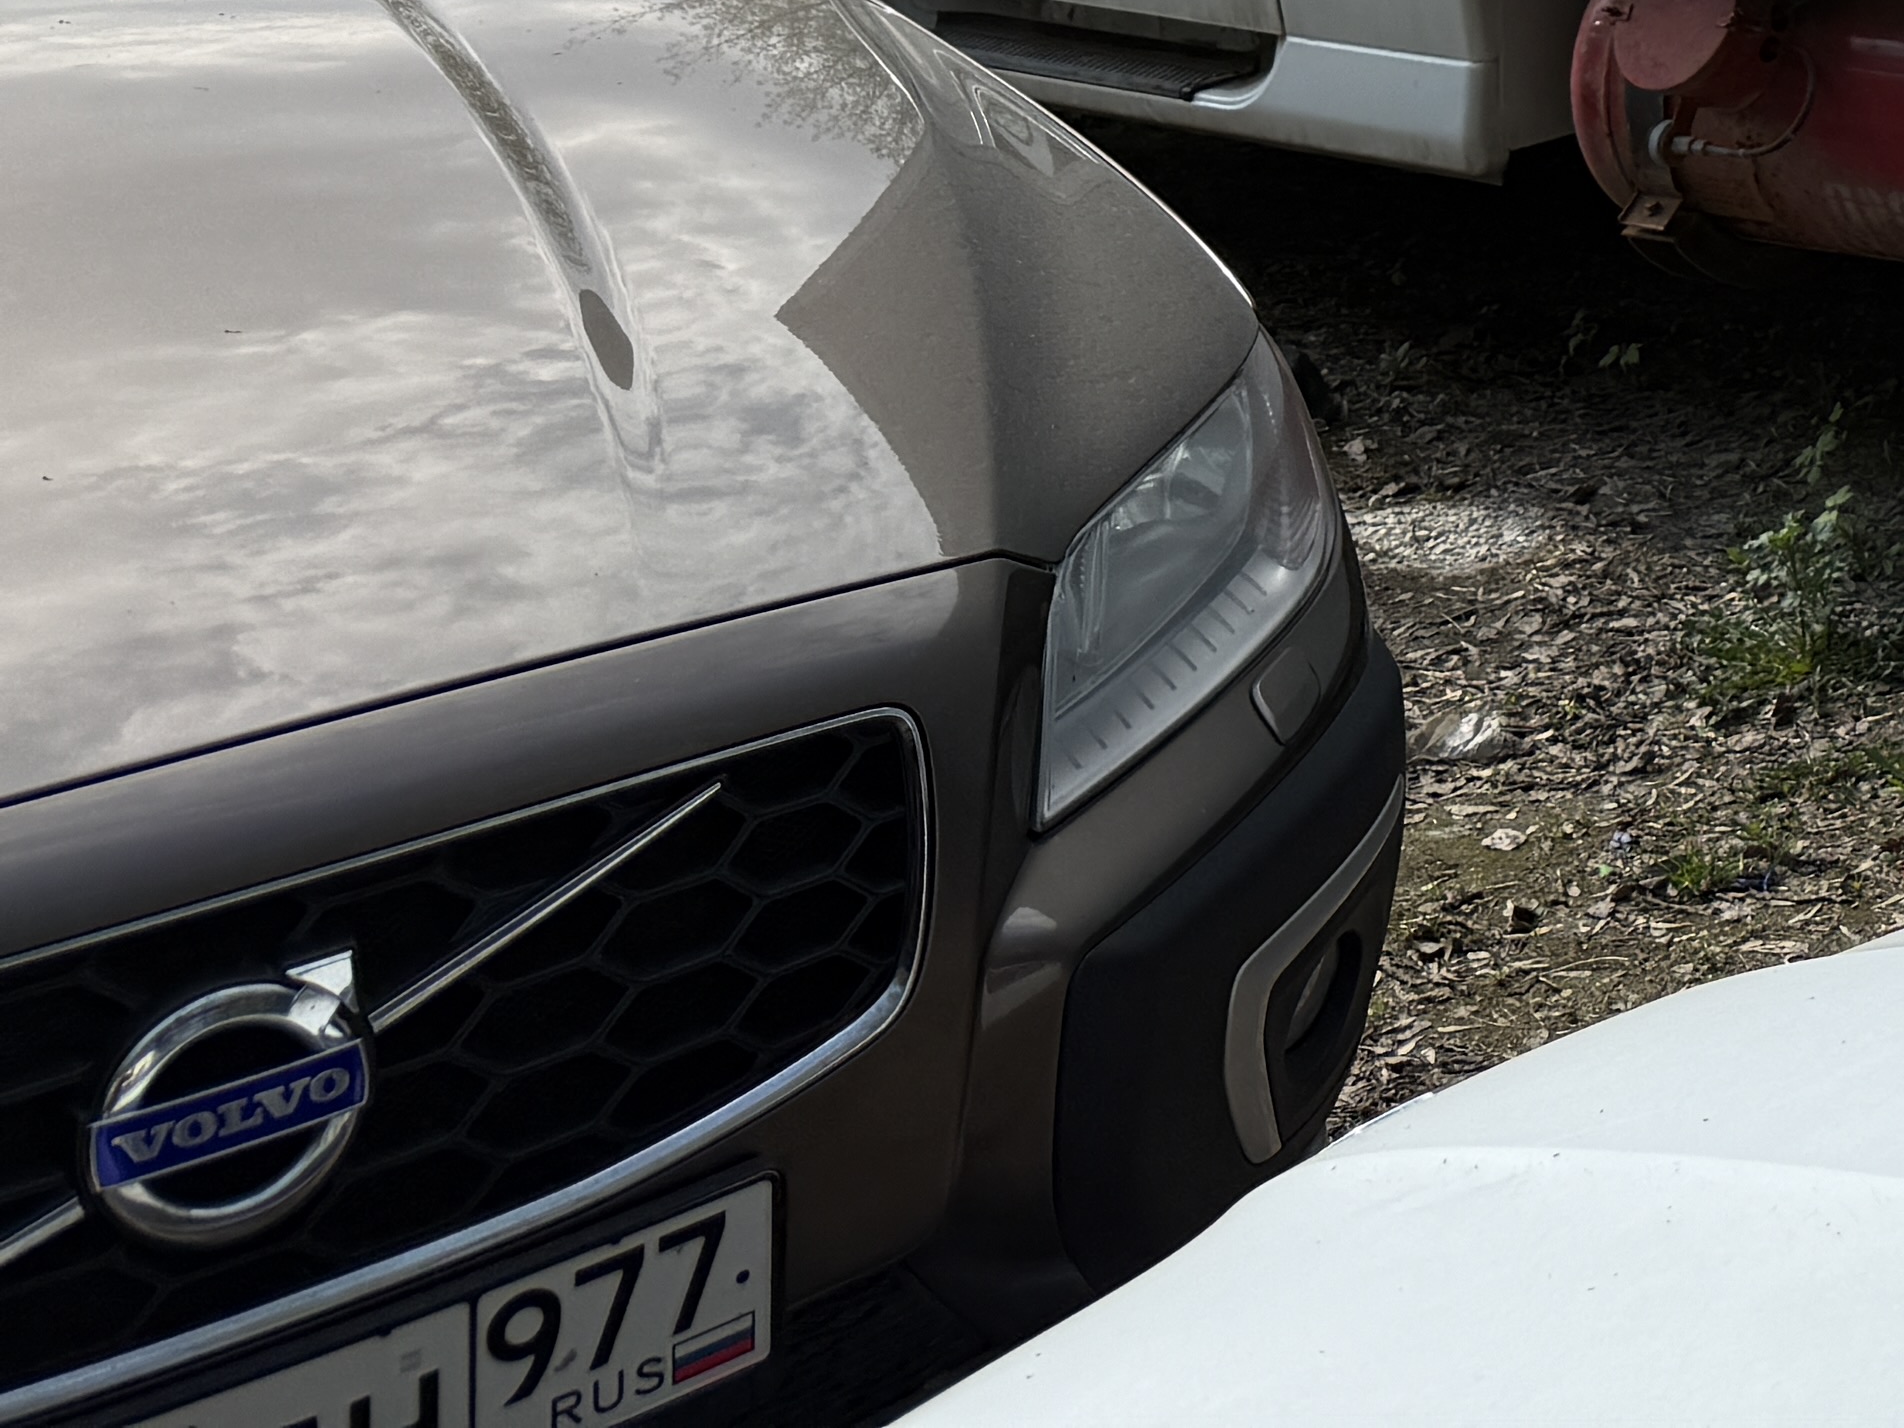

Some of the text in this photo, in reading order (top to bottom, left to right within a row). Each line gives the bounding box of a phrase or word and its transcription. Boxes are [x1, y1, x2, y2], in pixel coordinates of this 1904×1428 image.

[111, 1067, 350, 1163] VOLVO
[486, 1210, 726, 1407] 977
[552, 1357, 664, 1428] RUS
